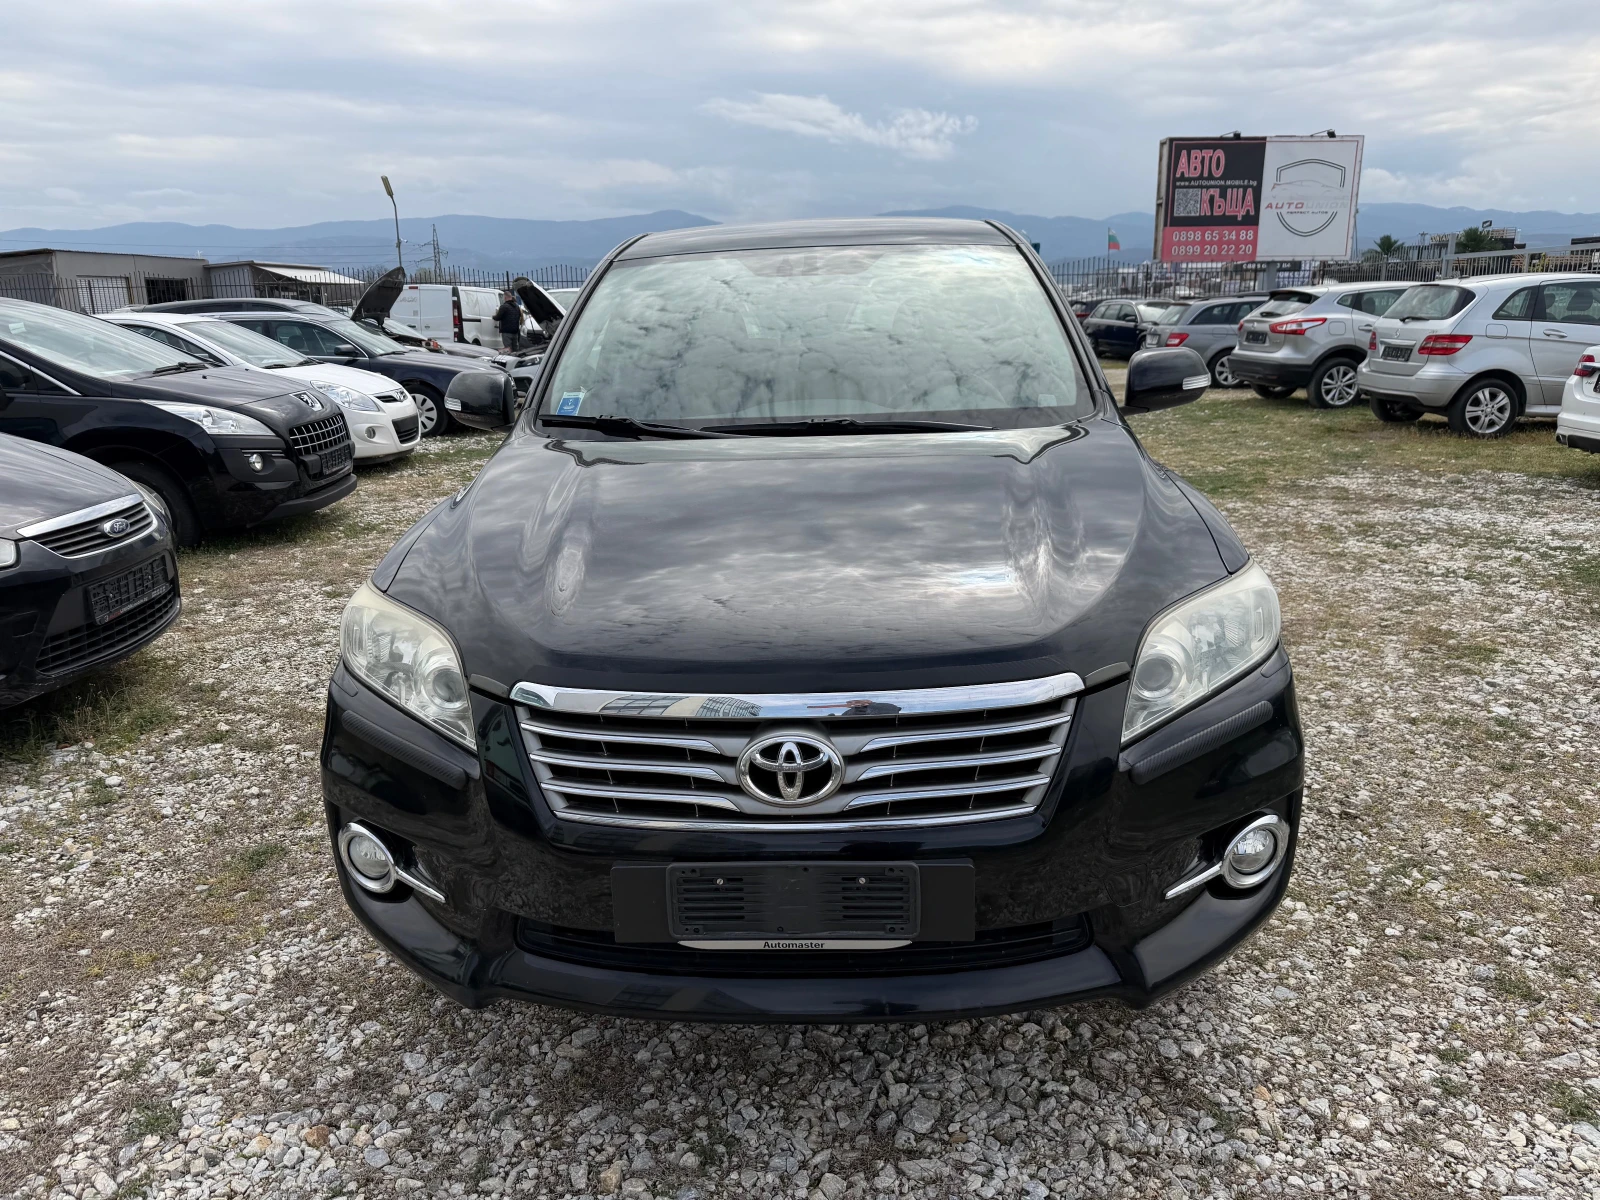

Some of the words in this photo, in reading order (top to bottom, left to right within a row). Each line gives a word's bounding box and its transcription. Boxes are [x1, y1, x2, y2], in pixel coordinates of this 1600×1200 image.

[1176, 149, 1225, 178] АВТО
[1200, 188, 1255, 220] КЪЩА
[1173, 230, 1201, 241] 0898
[1204, 230, 1219, 241] 65
[1222, 230, 1236, 241] 34
[1239, 230, 1254, 241] 88
[1171, 245, 1200, 256] 0899
[1203, 245, 1218, 255] 20
[1220, 244, 1235, 255] 22
[1238, 244, 1253, 255] 20
[763, 941, 825, 949] Automaster
